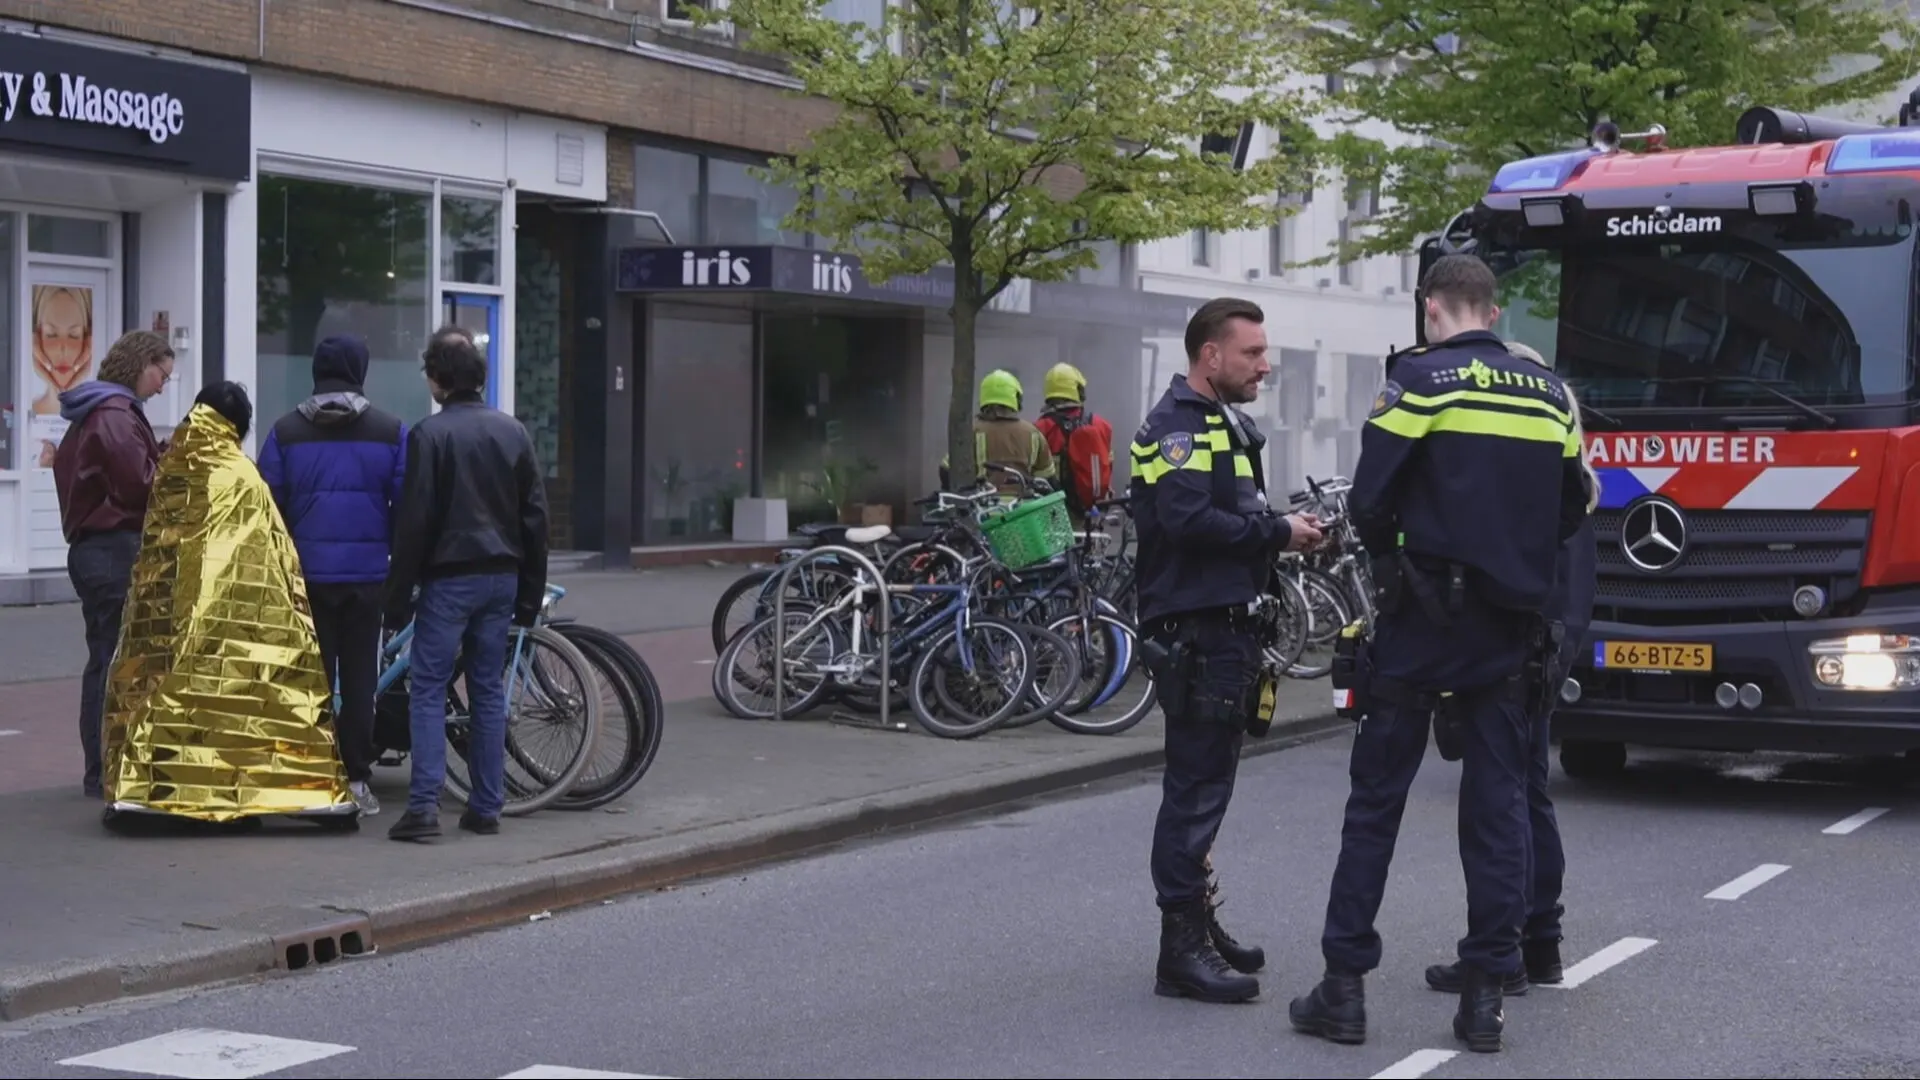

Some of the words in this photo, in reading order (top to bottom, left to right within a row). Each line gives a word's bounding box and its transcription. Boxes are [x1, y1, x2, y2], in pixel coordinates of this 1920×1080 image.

[30, 71, 53, 116] &
[59, 72, 184, 144] Massage
[682, 250, 751, 286] iris
[812, 253, 852, 294] iris
[1456, 361, 1549, 392] POLITIE
[1587, 436, 1776, 463] ANDWEER
[1613, 645, 1705, 667] 66-BTZ-5
